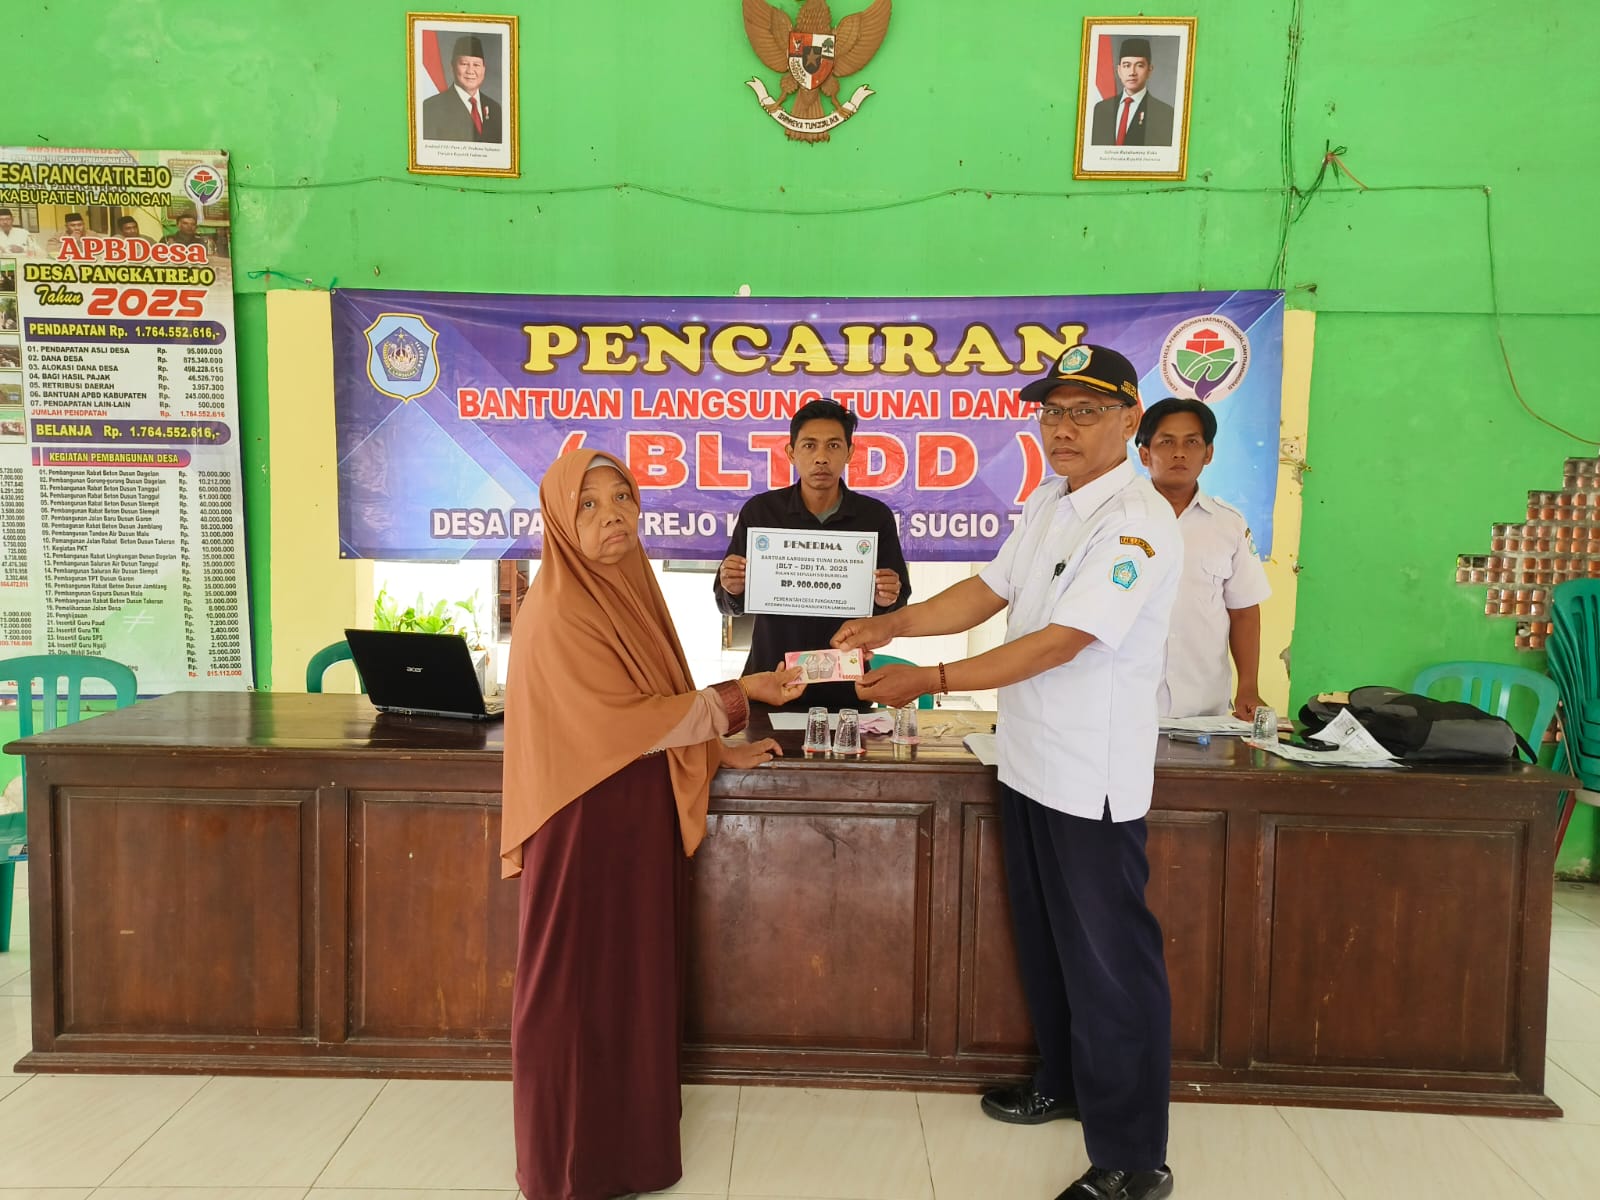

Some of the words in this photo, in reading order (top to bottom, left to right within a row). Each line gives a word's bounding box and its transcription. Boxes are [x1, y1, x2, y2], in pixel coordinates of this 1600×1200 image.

[0, 164, 33, 183] ESA
[39, 164, 171, 187] PANGKATREJO
[0, 190, 85, 204] KABUPATEN
[89, 192, 171, 206] LAMONGAN
[57, 237, 207, 264] APBDesa
[26, 265, 76, 281] DESA
[82, 266, 214, 284] PANGKATREJO
[35, 286, 83, 305] Tahun
[87, 288, 207, 317] 2025
[29, 323, 106, 336] PENDAPATAN
[109, 324, 128, 339] Rp.
[135, 326, 220, 340] 1.764.552.616,-
[522, 323, 1088, 375] PENCAIRAN
[457, 387, 622, 420] BANTUAN
[631, 388, 822, 420] LANGSUN
[832, 388, 939, 420] TUNAI
[952, 389, 1041, 420] DANA
[160, 410, 171, 418] Rp.
[35, 424, 92, 437] BELANJA
[103, 425, 122, 439] Rp.
[129, 426, 221, 439] 1.764.552.616,-
[49, 452, 88, 462] KEGIATAN
[91, 453, 154, 463] PEMBANGUNAN
[157, 454, 178, 463] DESA
[625, 430, 796, 490] BLT
[846, 430, 979, 491] DD
[49, 469, 85, 477] Pembangunan
[432, 511, 506, 537] DESA
[513, 511, 716, 538] PAREJO
[909, 512, 1001, 538] SUGIO
[784, 540, 842, 551] PENERIMA
[781, 580, 795, 588] RP.
[797, 581, 841, 590] 900.000,00
